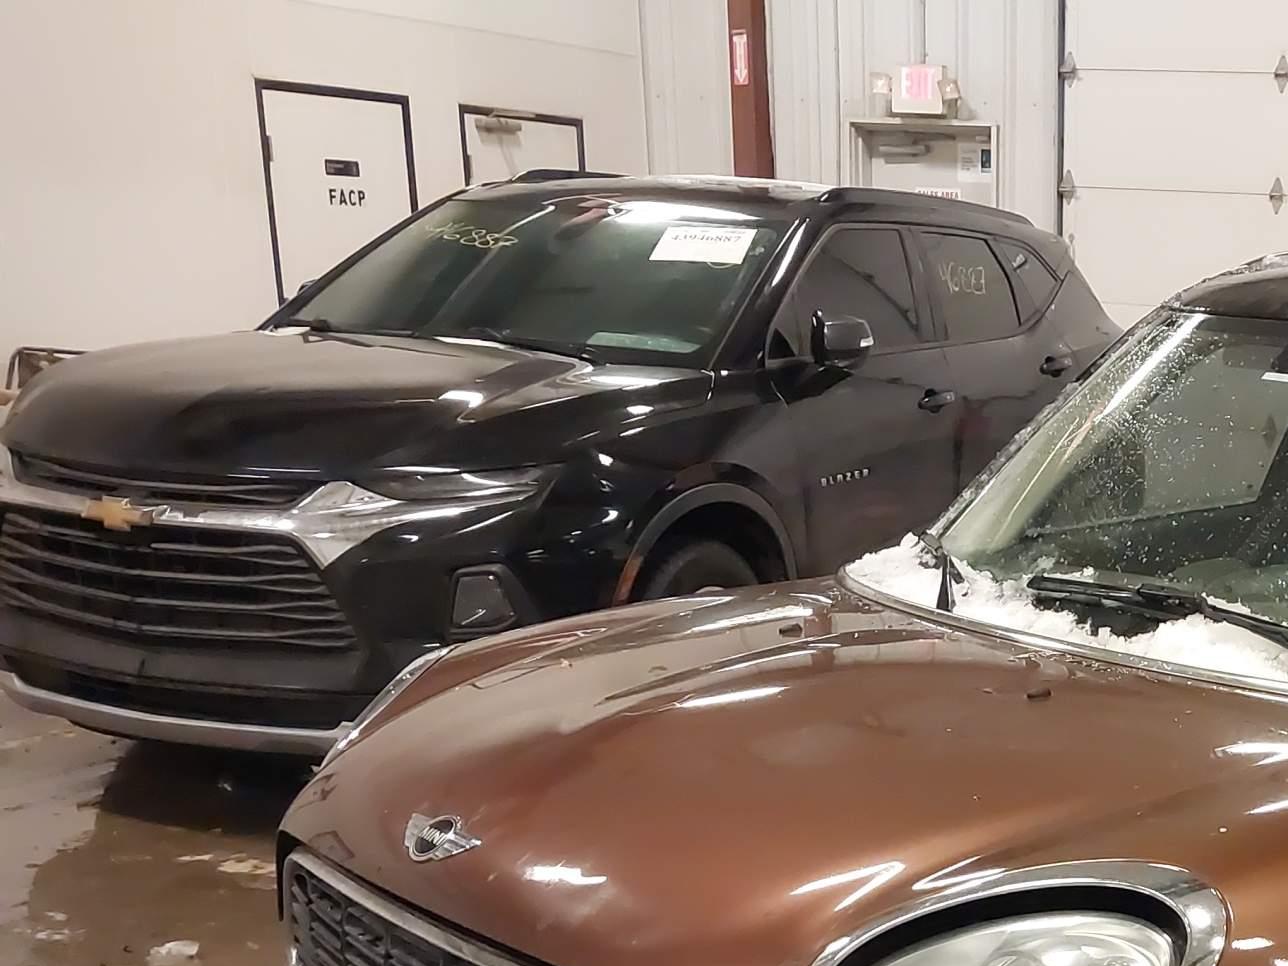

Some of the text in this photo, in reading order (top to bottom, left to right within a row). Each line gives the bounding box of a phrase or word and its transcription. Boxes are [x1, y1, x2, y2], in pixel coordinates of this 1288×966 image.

[328, 188, 366, 207] FACP
[820, 468, 870, 487] BLAZER
[418, 826, 448, 846] MINI
